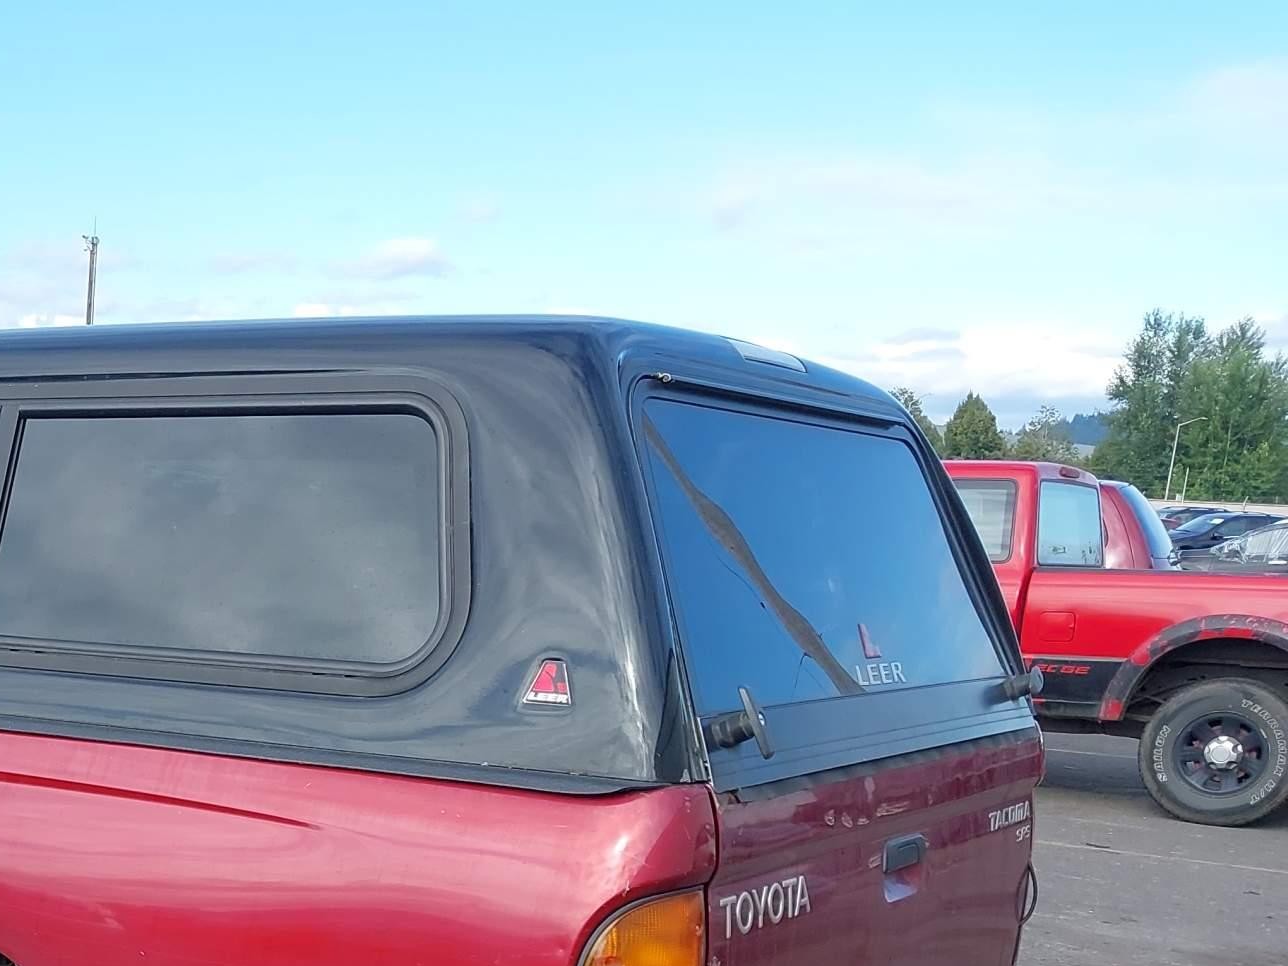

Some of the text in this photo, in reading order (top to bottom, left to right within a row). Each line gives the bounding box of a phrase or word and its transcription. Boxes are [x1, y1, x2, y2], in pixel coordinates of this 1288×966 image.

[855, 662, 907, 686] LEER
[526, 691, 569, 703] LEER
[988, 800, 1030, 832] TACOMA
[719, 875, 811, 939] TOYOTA
